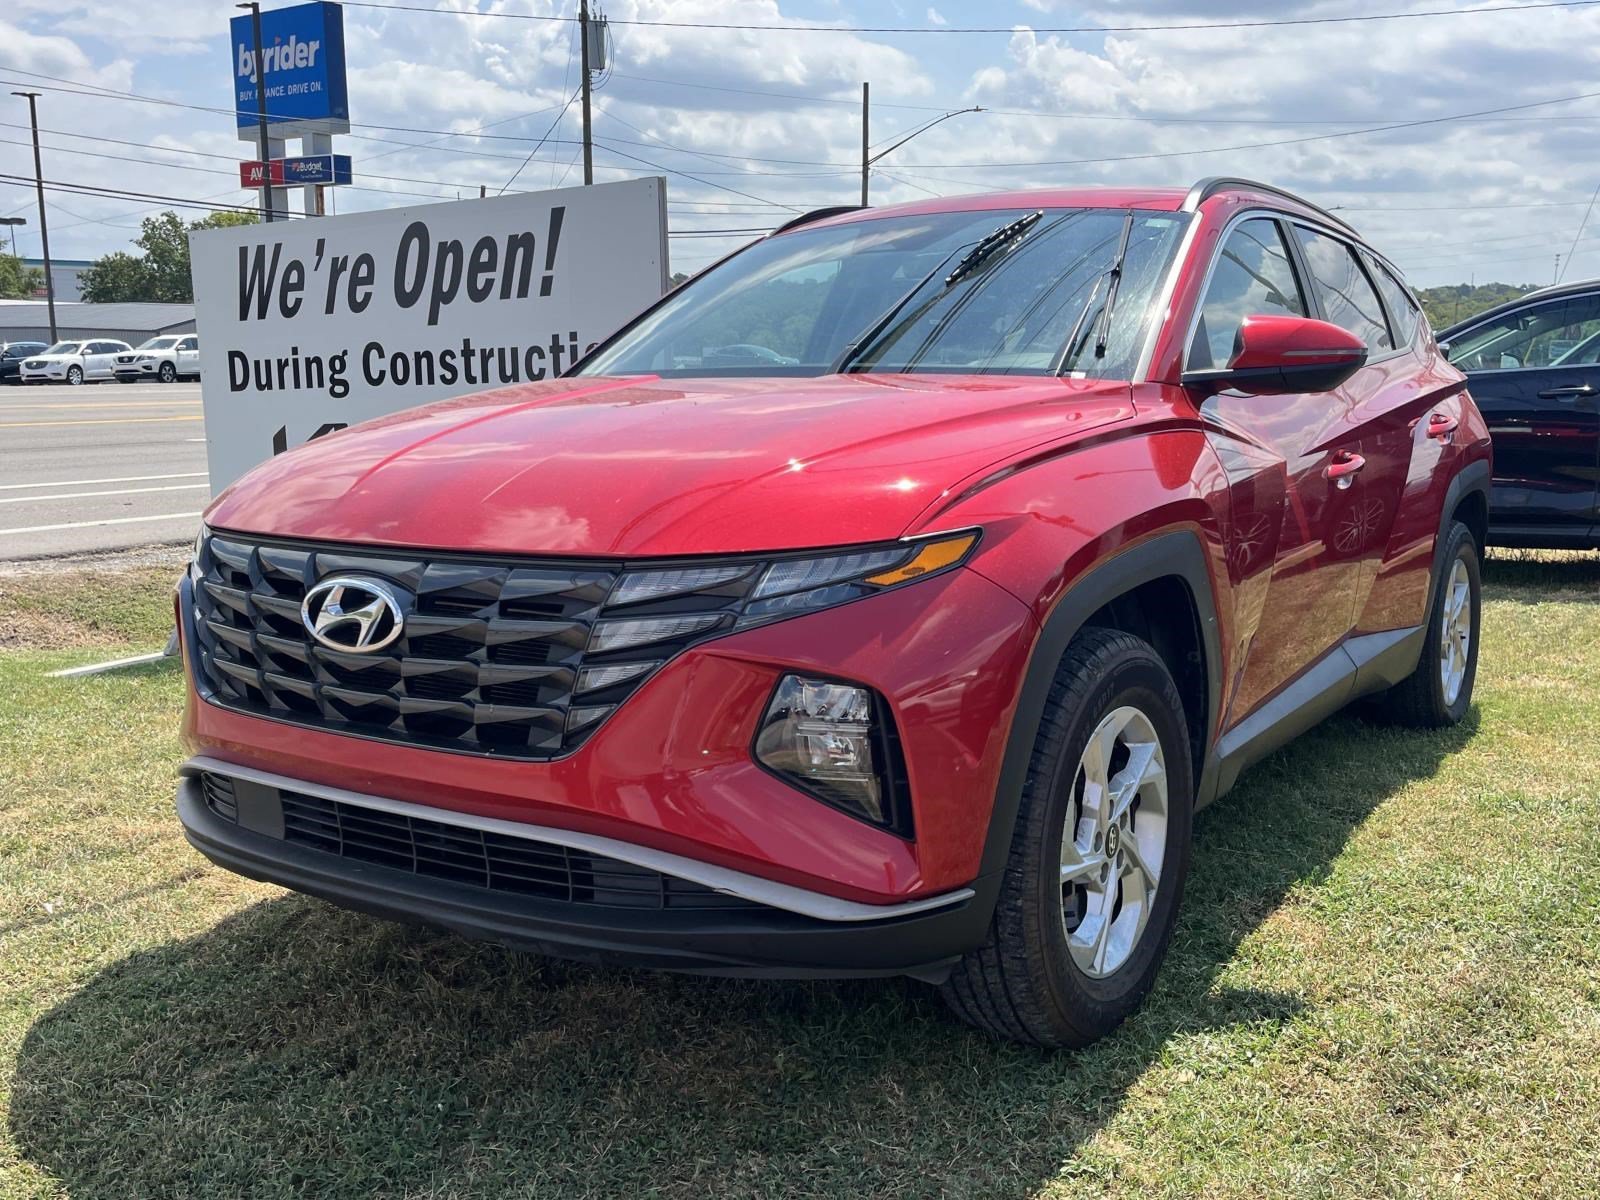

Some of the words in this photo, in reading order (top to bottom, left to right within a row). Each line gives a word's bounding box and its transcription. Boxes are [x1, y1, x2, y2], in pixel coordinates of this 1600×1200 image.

[287, 83, 309, 95] DRIVE
[238, 238, 375, 321] We're
[393, 206, 566, 326] Open!
[227, 346, 350, 398] During
